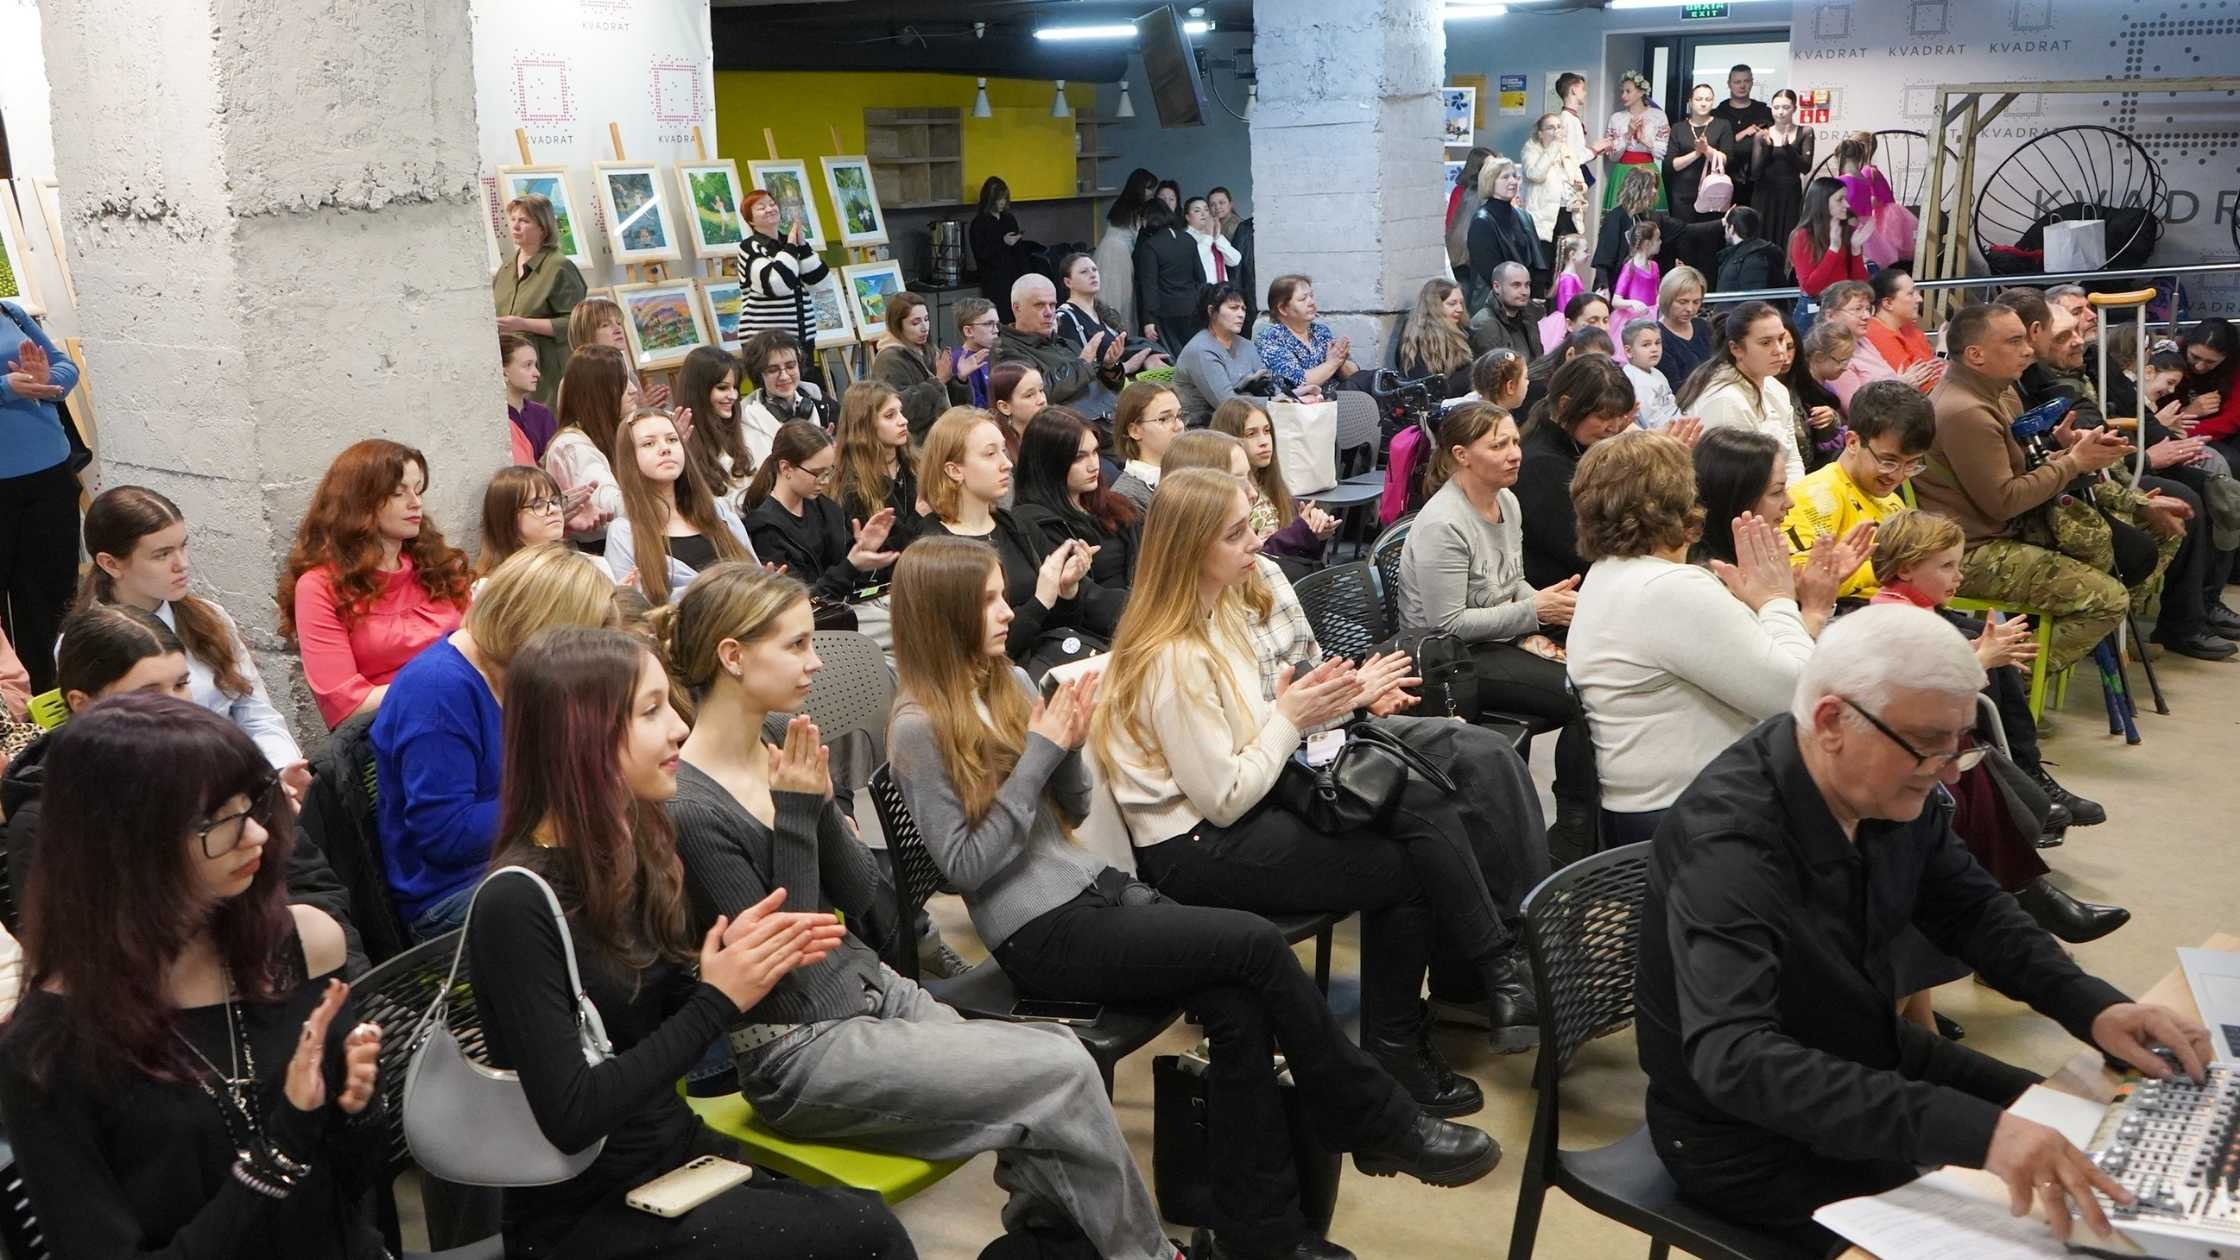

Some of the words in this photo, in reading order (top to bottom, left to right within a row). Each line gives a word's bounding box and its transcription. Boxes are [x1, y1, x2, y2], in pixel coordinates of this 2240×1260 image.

[581, 21, 631, 33] KVADRAT
[1888, 44, 1967, 57] KVADRAT
[1989, 39, 2073, 53] KVADRAT
[1794, 47, 1868, 60] KVADRAT
[658, 134, 696, 144] KVADRA
[1981, 126, 2051, 139] KVADRA
